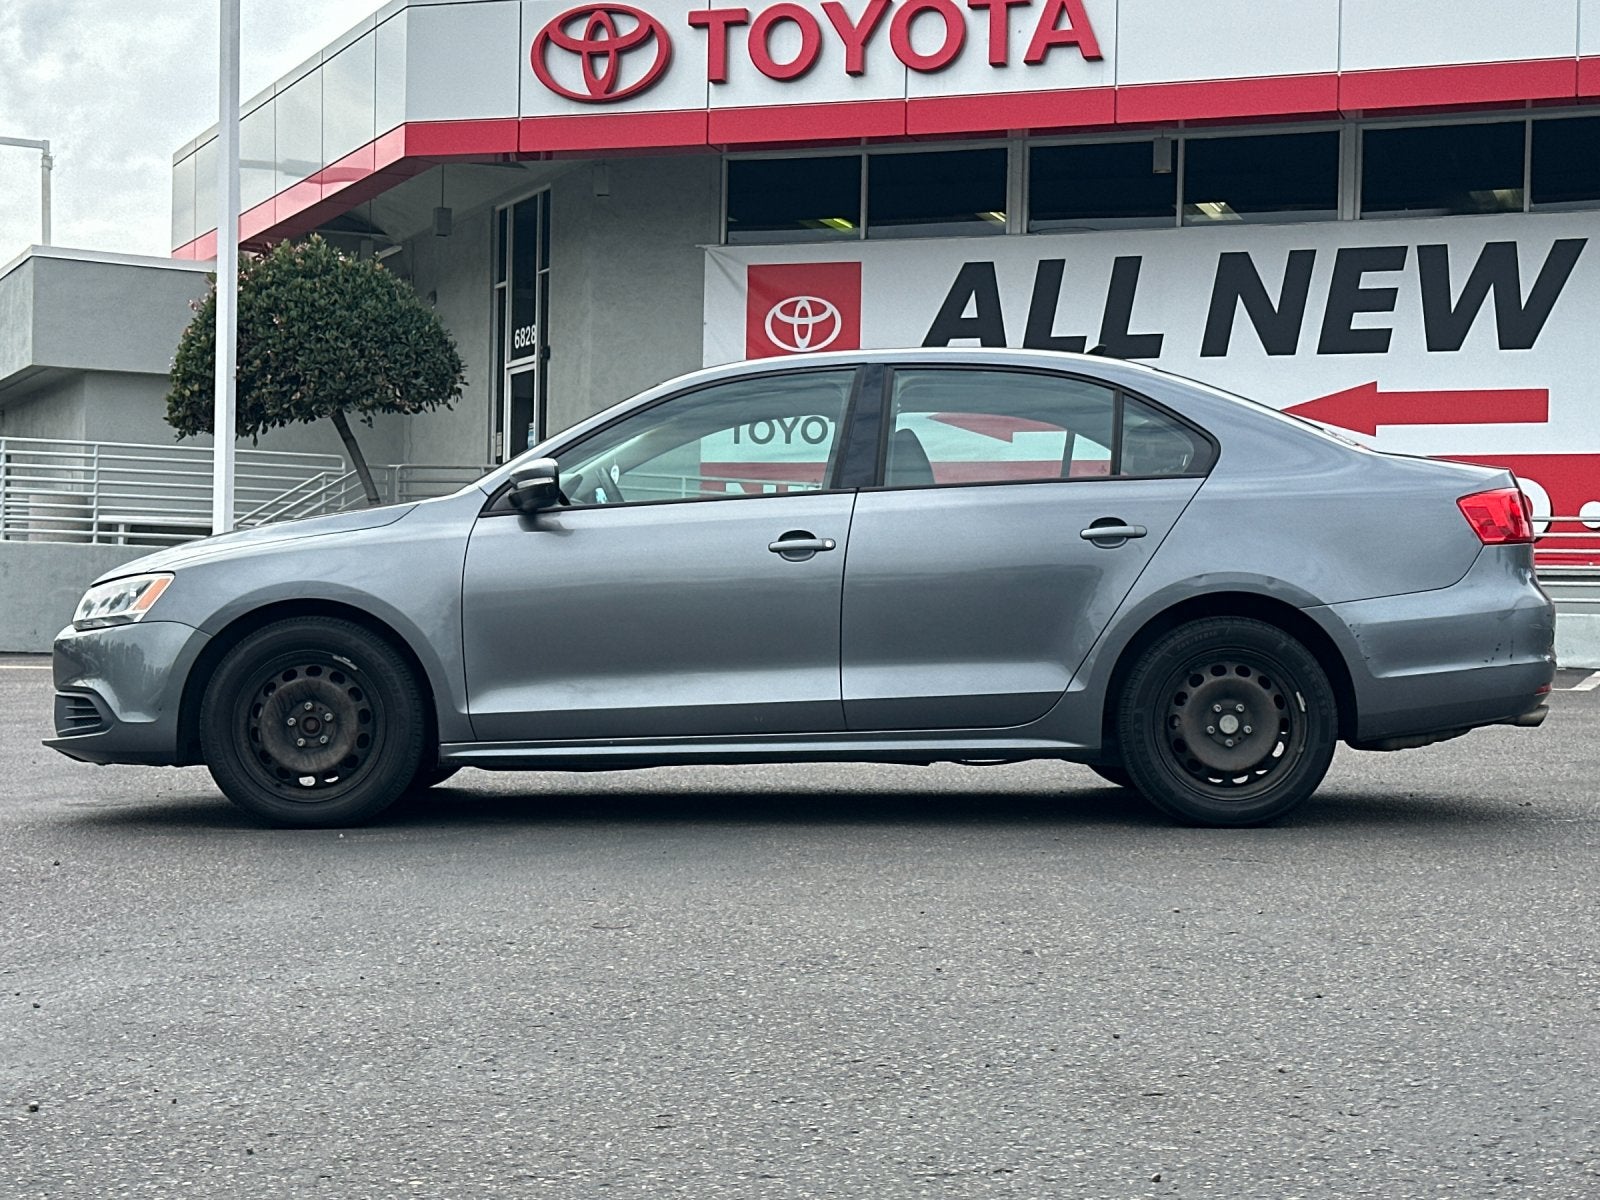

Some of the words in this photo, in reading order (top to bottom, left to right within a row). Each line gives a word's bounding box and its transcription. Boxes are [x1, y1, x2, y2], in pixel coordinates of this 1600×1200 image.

[687, 0, 1103, 84] TOYOTA
[514, 324, 537, 349] 6828
[921, 255, 1164, 359] ALL
[1200, 238, 1588, 357] NEW
